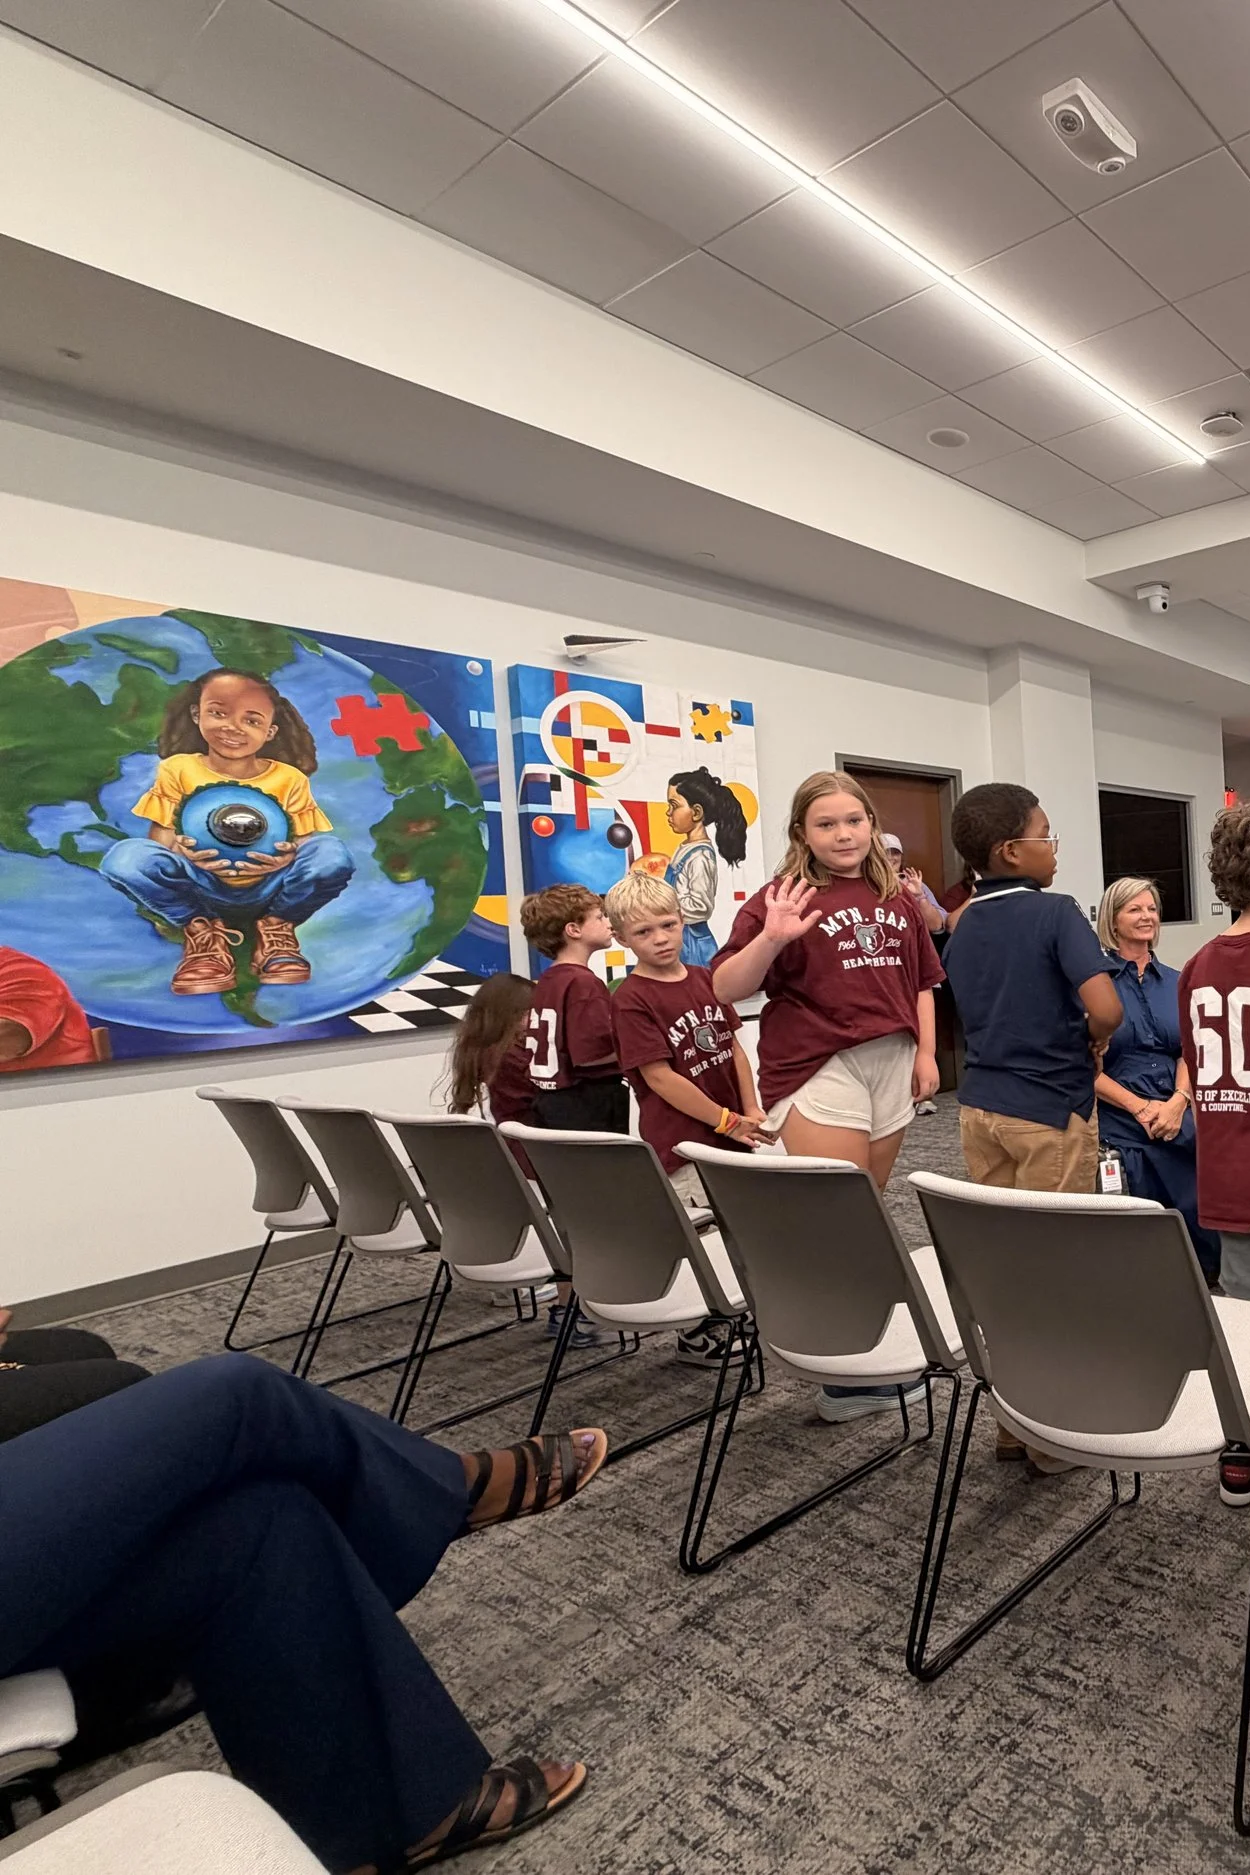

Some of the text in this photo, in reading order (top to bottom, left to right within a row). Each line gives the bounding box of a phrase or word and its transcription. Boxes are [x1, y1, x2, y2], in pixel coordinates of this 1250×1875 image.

[818, 907, 908, 938] MTN. GAP
[704, 1005, 726, 1022] GA
[1204, 1090, 1219, 1102] OF
